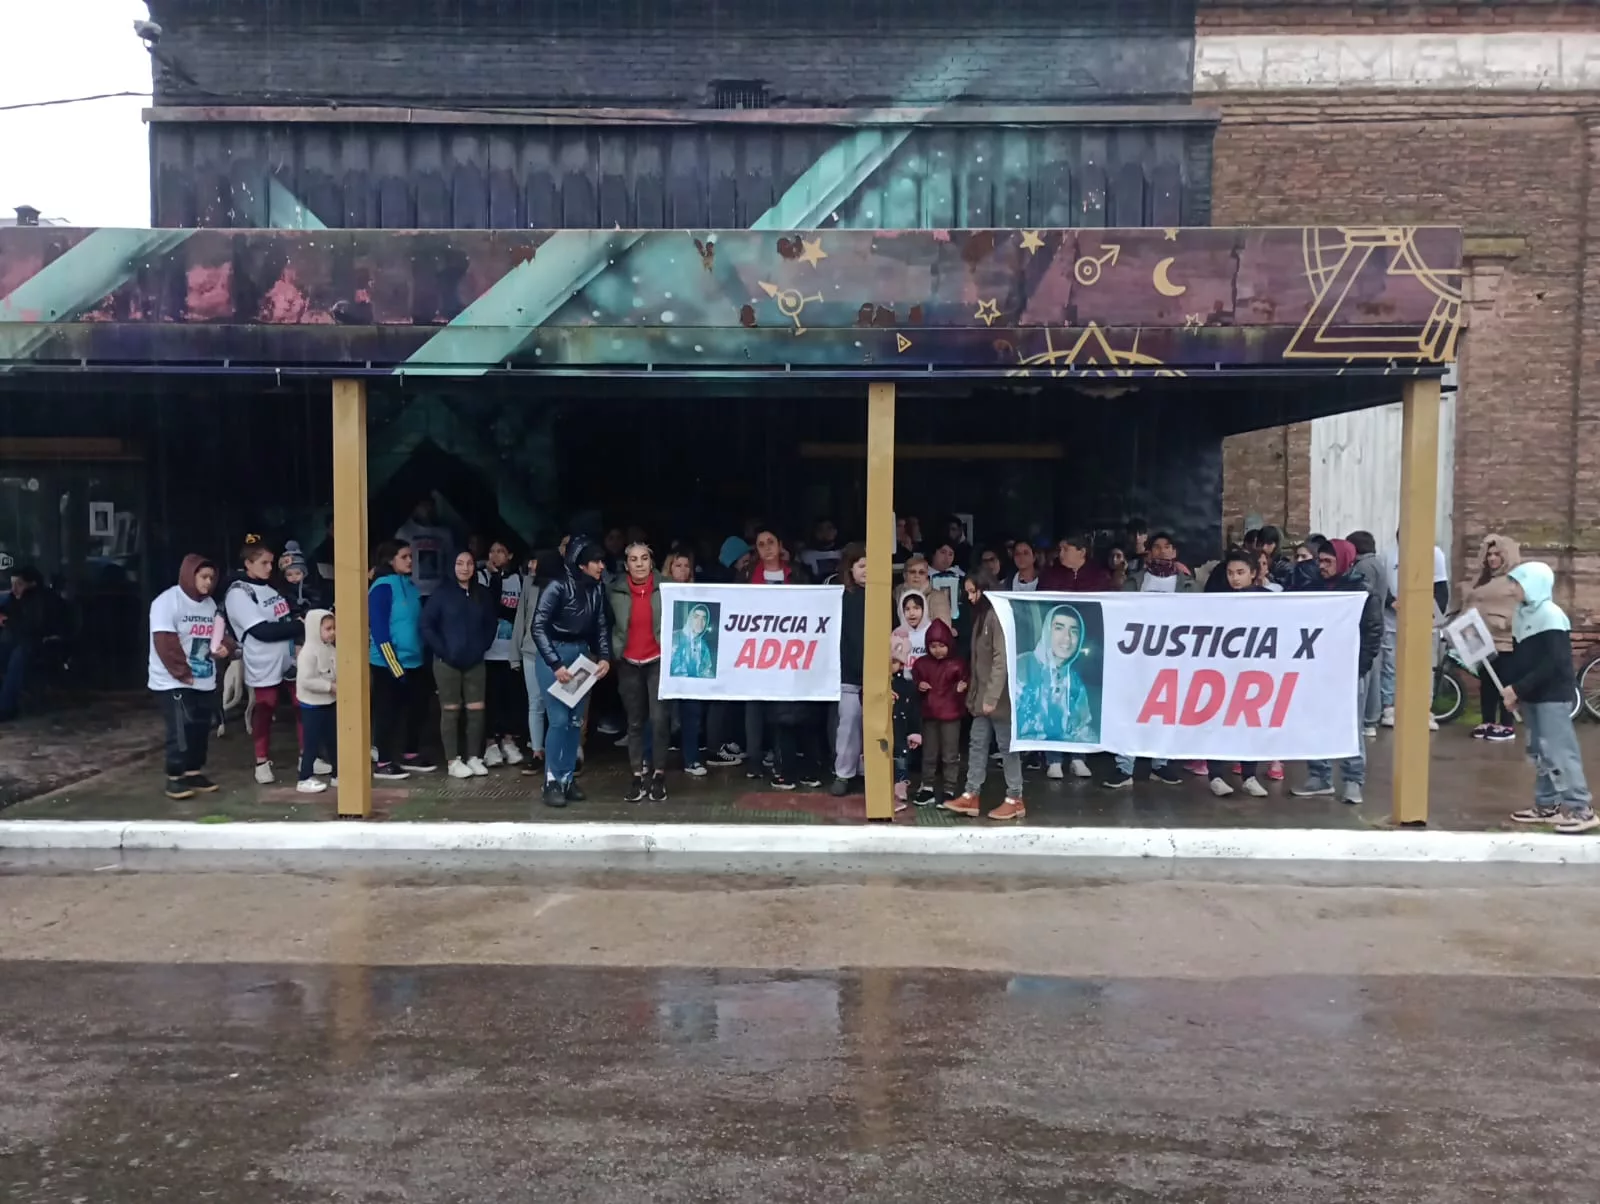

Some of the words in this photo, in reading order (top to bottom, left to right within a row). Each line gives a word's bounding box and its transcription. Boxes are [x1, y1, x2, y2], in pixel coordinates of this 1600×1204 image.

[189, 623, 214, 637] ADR
[724, 614, 808, 634] JUSTICIA
[815, 616, 831, 634] X
[734, 638, 818, 670] ADRI
[1117, 623, 1278, 659] JUSTICIA
[1292, 627, 1323, 660] X
[1137, 668, 1300, 728] ADRI
